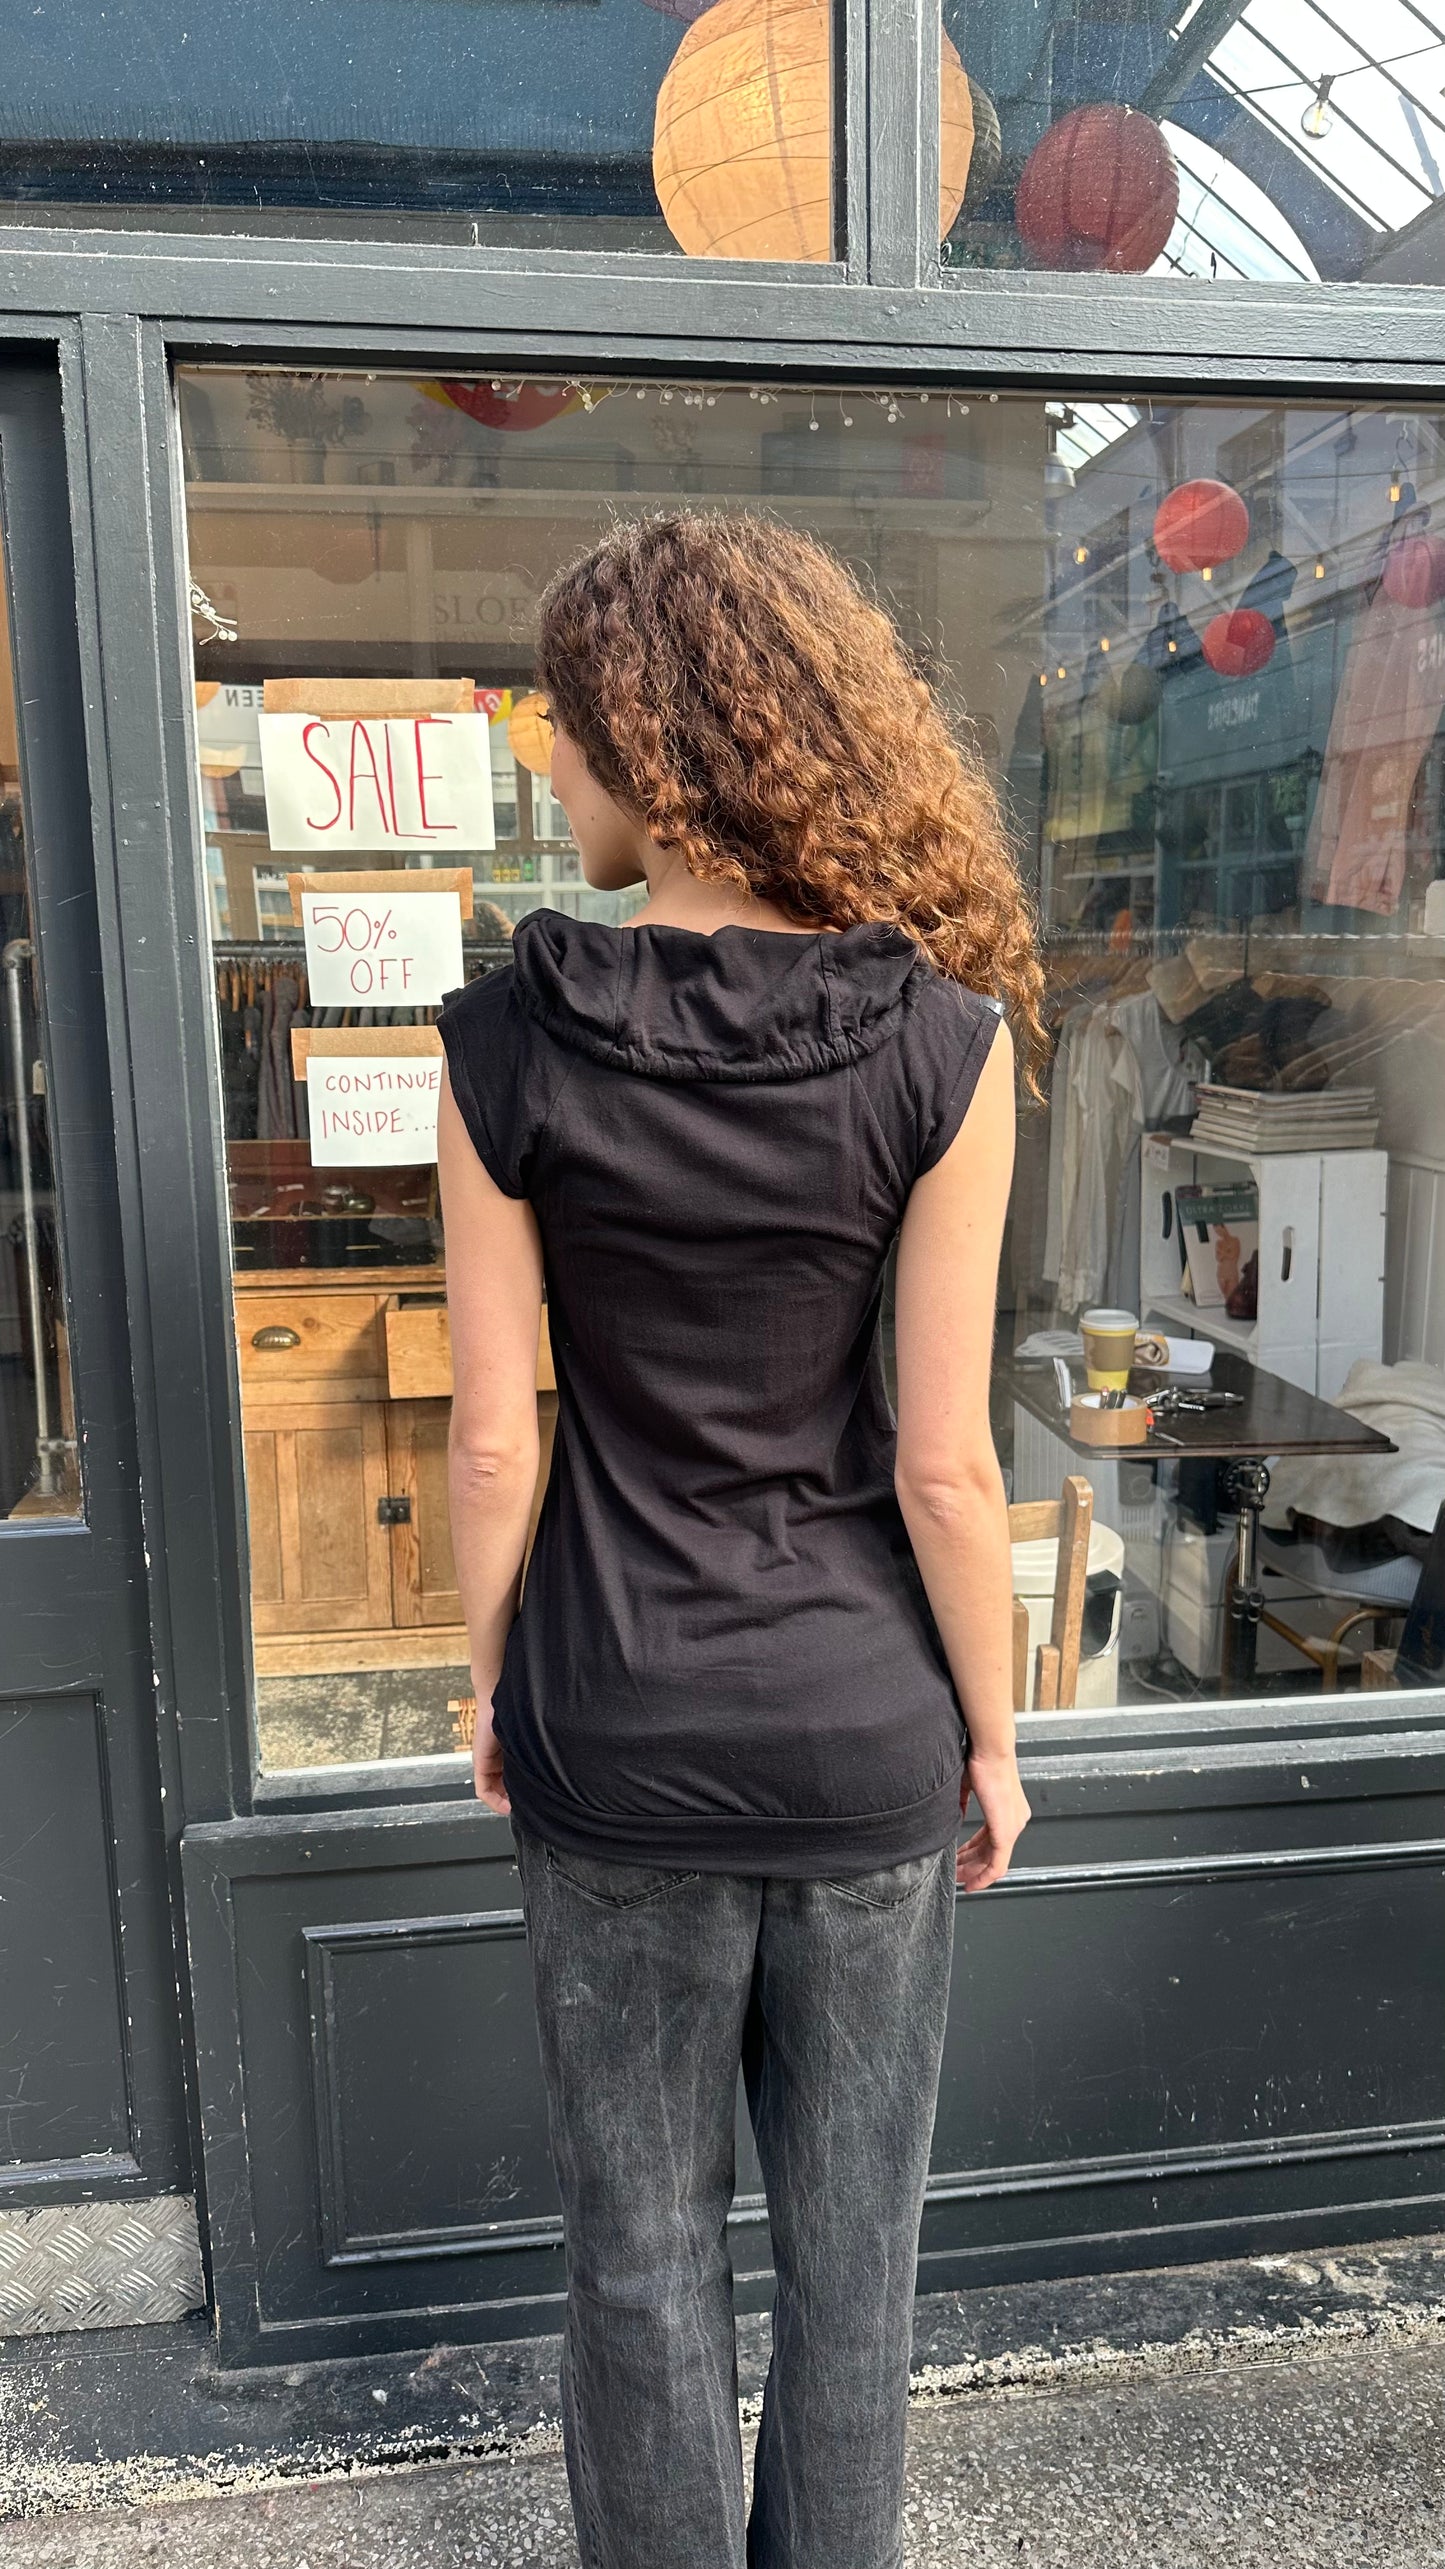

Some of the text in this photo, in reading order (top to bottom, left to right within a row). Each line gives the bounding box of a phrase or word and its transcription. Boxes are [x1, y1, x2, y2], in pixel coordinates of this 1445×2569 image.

[302, 718, 458, 838] SALE
[312, 906, 397, 953] 50%
[350, 957, 415, 994] OFF
[325, 1070, 439, 1093] CONTINUE
